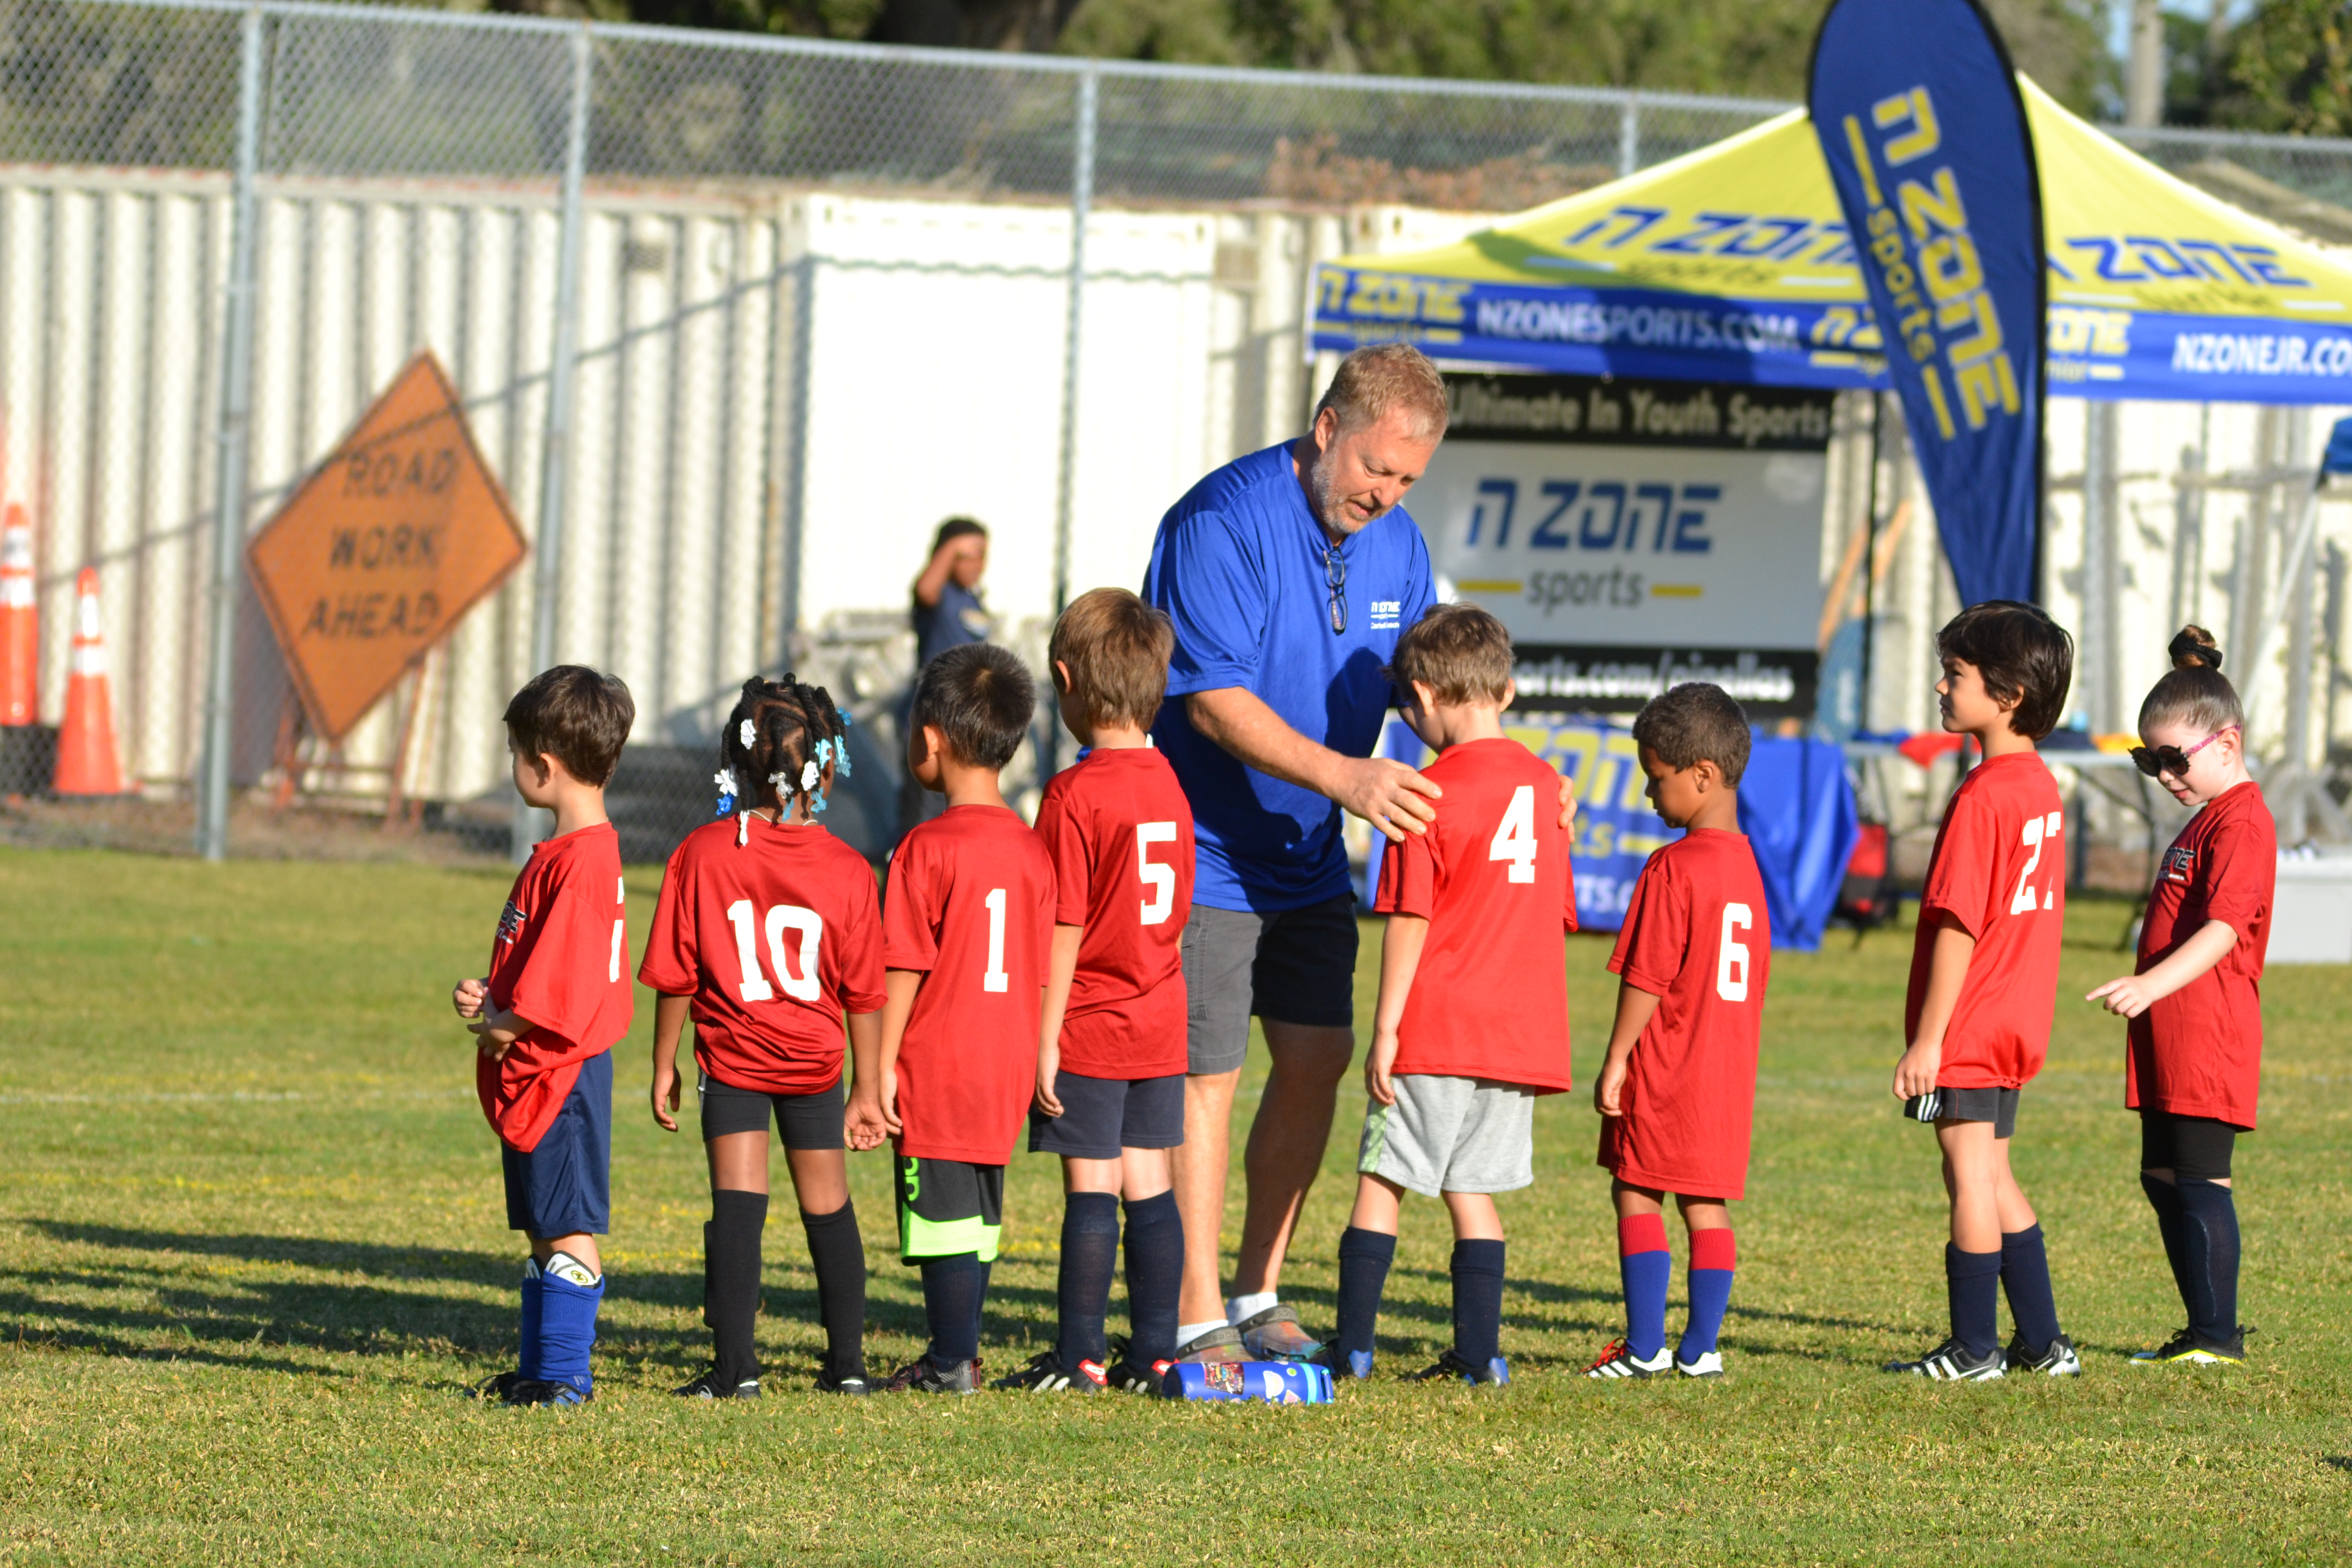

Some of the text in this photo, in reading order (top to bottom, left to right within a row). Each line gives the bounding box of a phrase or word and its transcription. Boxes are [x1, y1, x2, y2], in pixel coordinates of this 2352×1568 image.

[1866, 205, 1938, 362] sports
[1476, 298, 1802, 353] NZONESPORTS.COM
[2172, 332, 2352, 378] NZONEJR.CO
[1586, 388, 1621, 433] In
[1628, 389, 1721, 435] Youth
[1727, 393, 1827, 447] Sports
[343, 447, 459, 498] ROAD
[329, 525, 441, 572] WORK
[304, 591, 440, 639] AHEAD
[1527, 566, 1644, 616] sports
[1514, 650, 1795, 701] orts.com/pinellas
[1489, 786, 1537, 883] 4
[1136, 821, 1177, 925] 5
[727, 898, 823, 1002] 10
[984, 888, 1009, 993] 1
[1717, 902, 1753, 1002] 6
